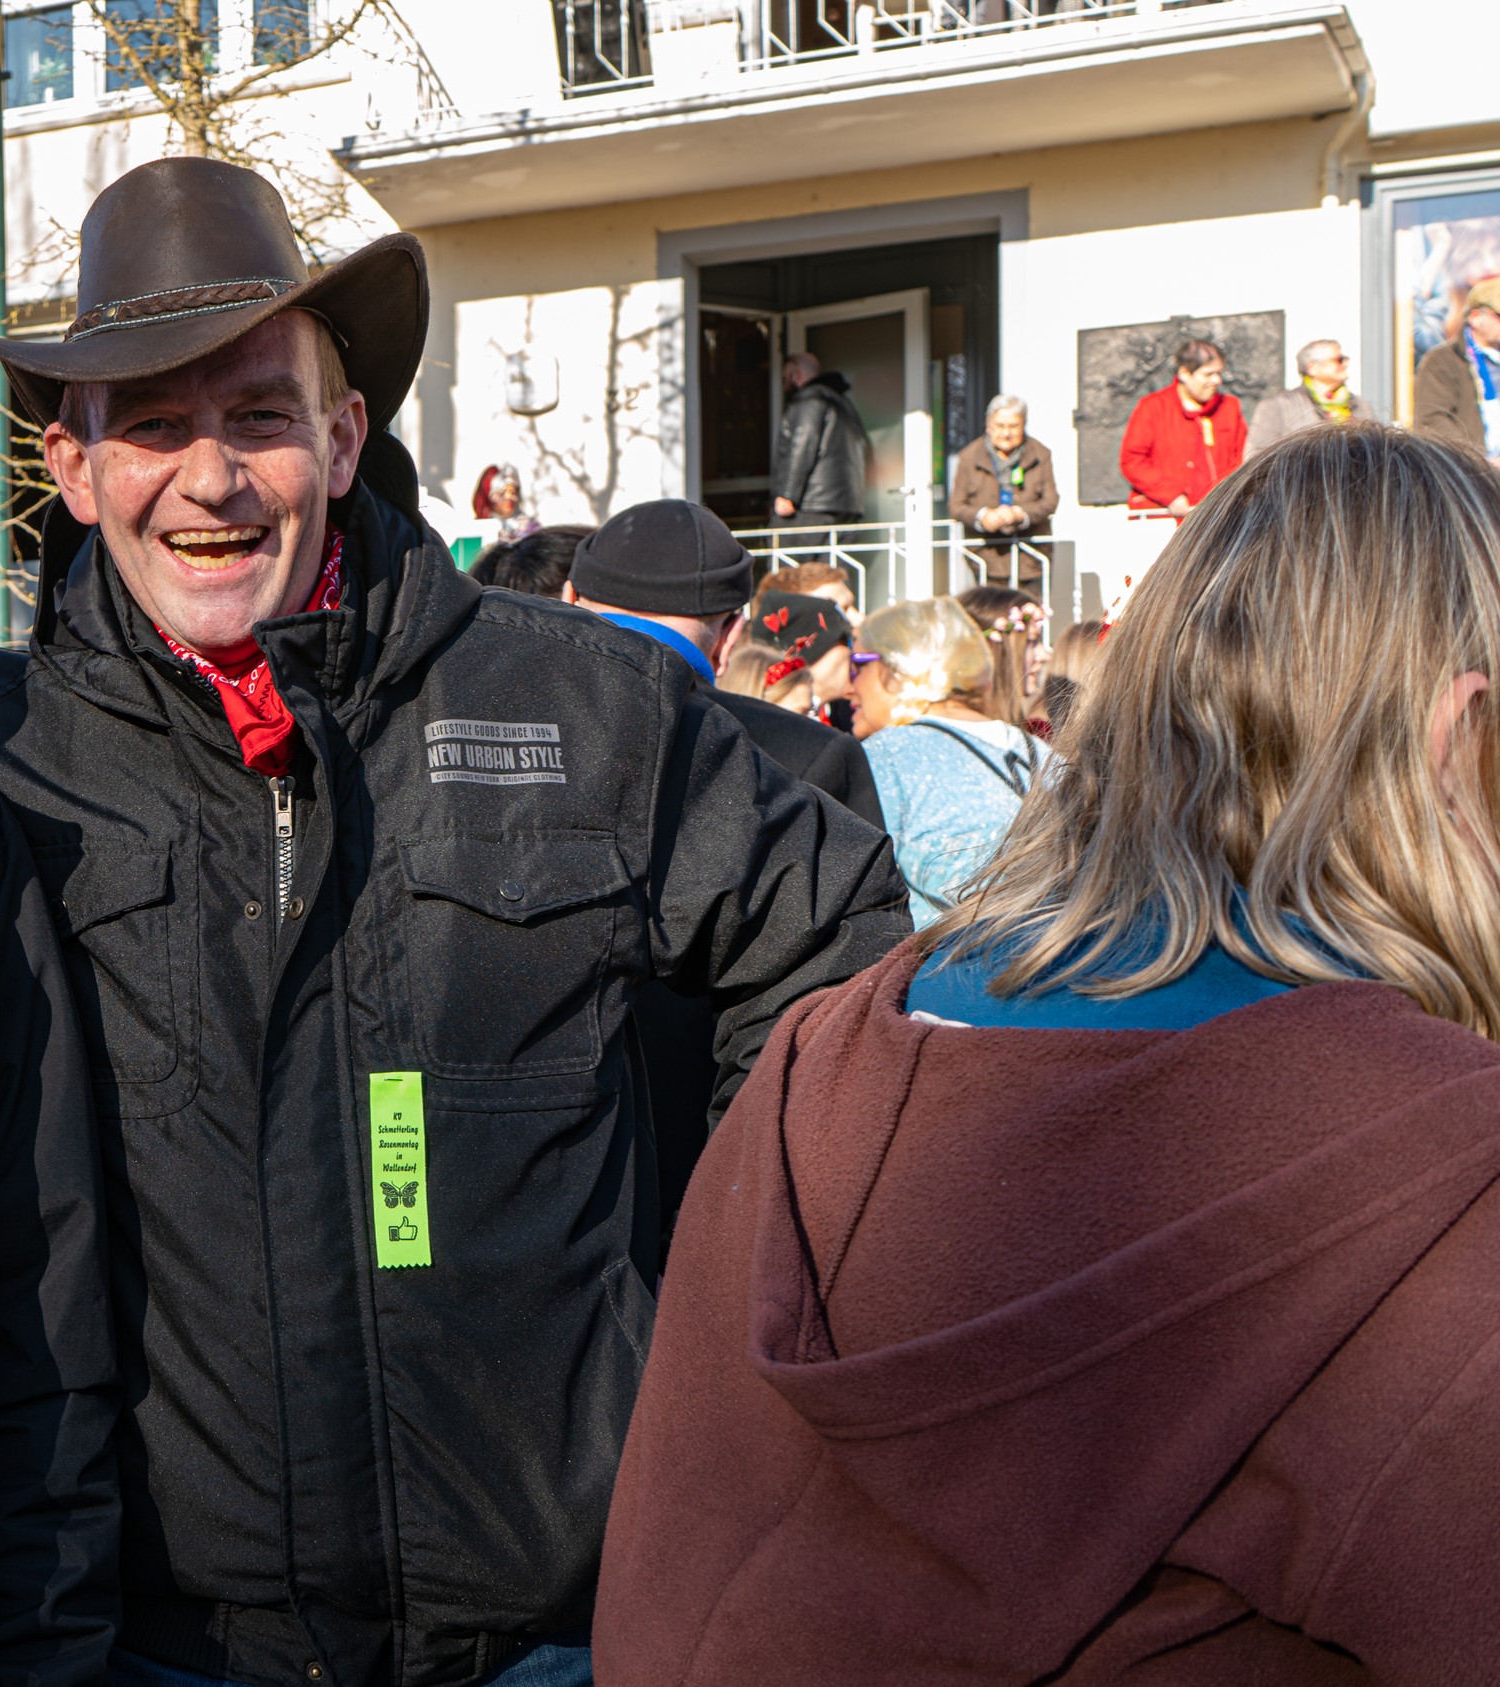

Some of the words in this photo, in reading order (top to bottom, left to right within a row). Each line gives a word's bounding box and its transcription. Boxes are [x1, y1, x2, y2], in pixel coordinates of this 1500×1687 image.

[431, 723, 472, 737] LIFESTYLE
[474, 724, 500, 738] GOODS
[502, 726, 528, 738] SINCE
[530, 726, 552, 739] 1994
[428, 743, 462, 768] NEW
[465, 744, 515, 769] URBAN
[519, 746, 564, 769] STYLE
[502, 775, 532, 783] ORIGINAL
[533, 774, 563, 782] CLOTHING
[378, 1125, 419, 1136] Schmetterling
[379, 1140, 419, 1151] Rosenmontag
[396, 1152, 403, 1160] in
[383, 1163, 417, 1174] Wallendorf
